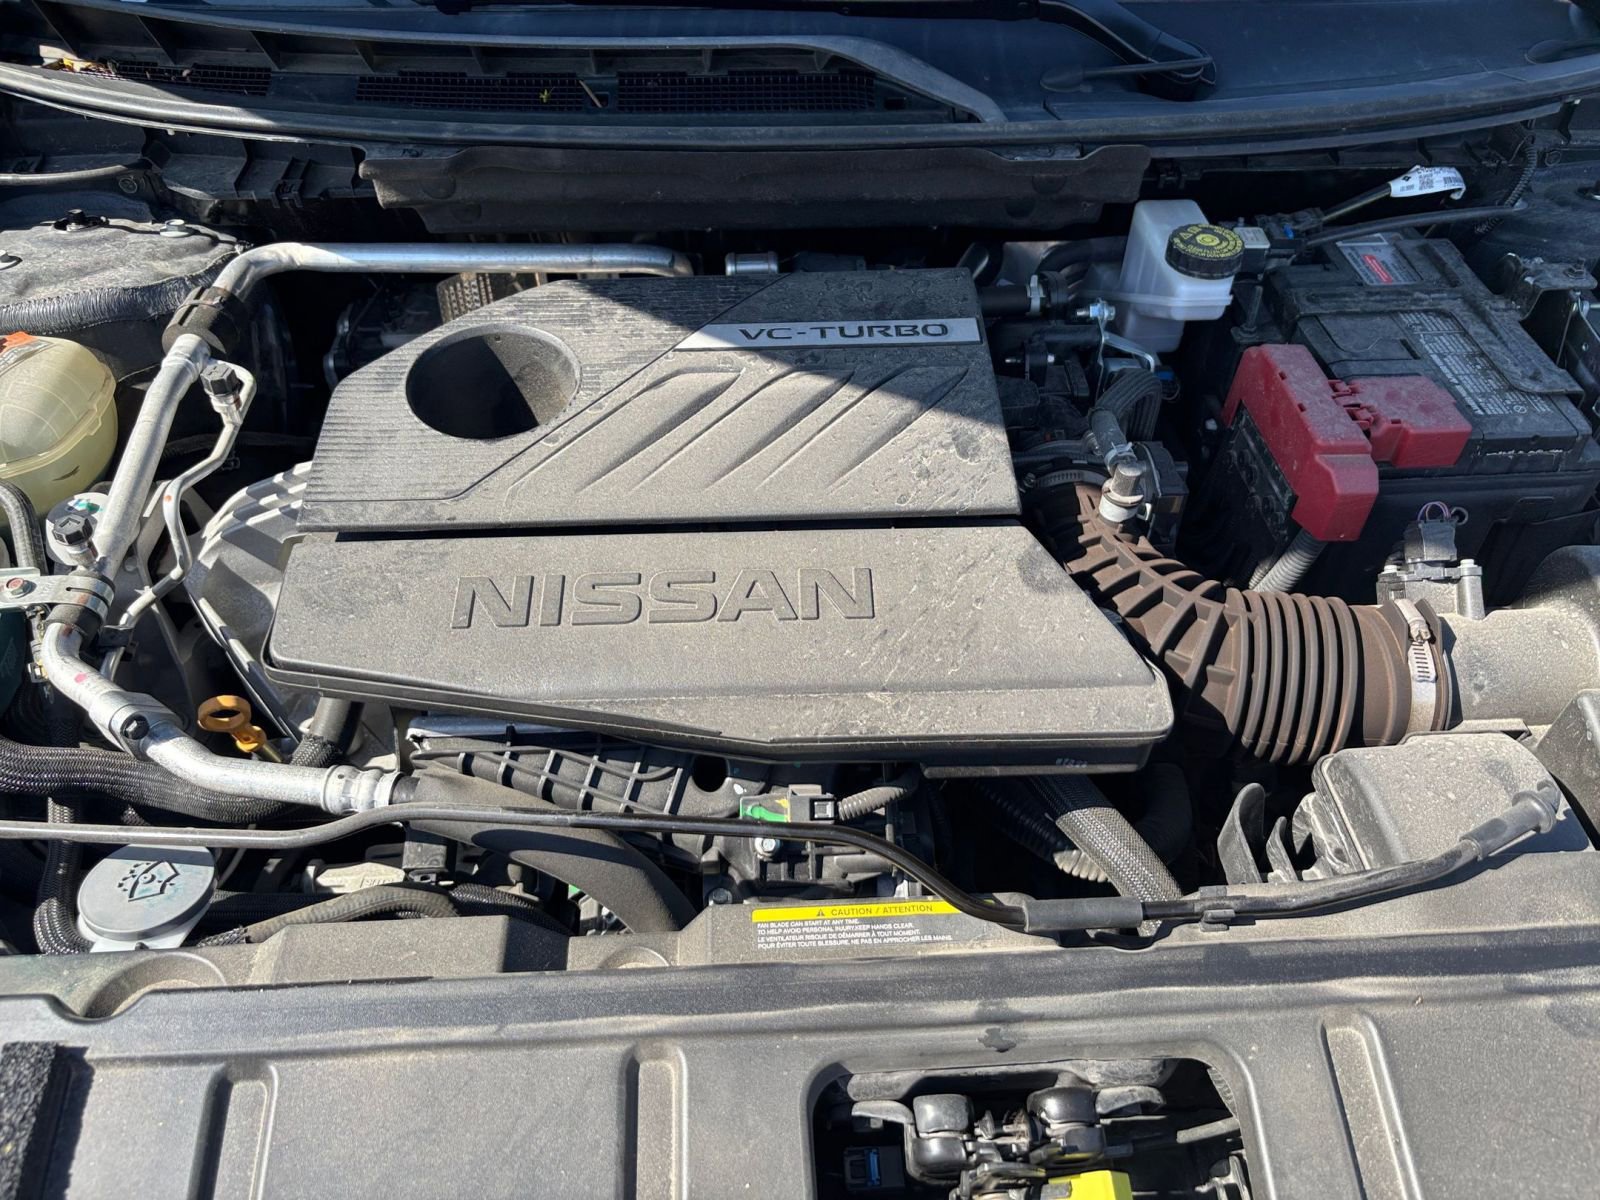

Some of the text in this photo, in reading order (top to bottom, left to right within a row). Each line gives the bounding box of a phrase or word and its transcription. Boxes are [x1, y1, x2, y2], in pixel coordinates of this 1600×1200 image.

[739, 323, 948, 341] VC-TURBO
[450, 567, 875, 629] NISSAN
[831, 908, 872, 916] CAUTION
[883, 904, 933, 914] ATTENTION
[766, 934, 804, 942] VENTILATEUR
[805, 933, 828, 941] RISQUE
[838, 930, 870, 939] DÉMARRER
[893, 928, 921, 936] MOMENT.
[802, 926, 834, 934] PERSONAL
[758, 942, 775, 950] POUR
[776, 941, 796, 949] ÉVITER
[797, 940, 816, 948] TOUTE
[883, 935, 920, 943] APPROCHER
